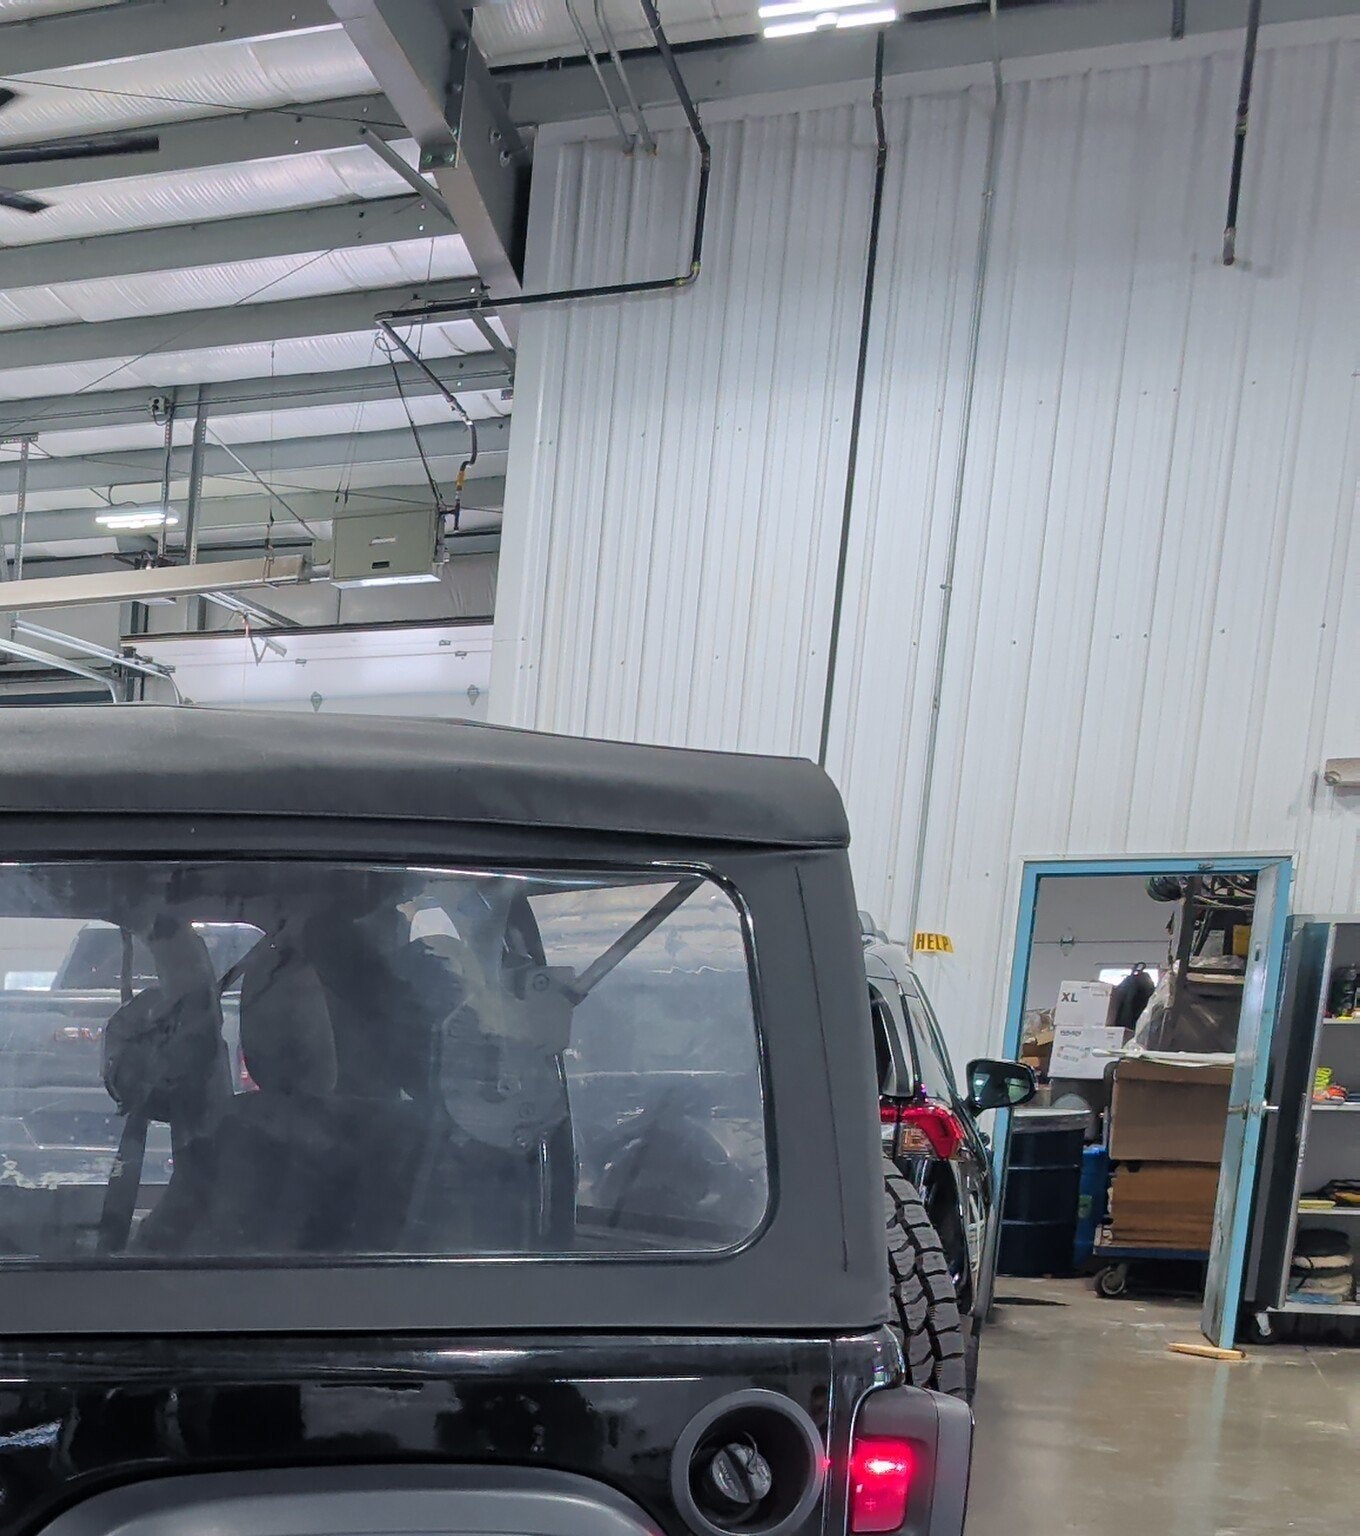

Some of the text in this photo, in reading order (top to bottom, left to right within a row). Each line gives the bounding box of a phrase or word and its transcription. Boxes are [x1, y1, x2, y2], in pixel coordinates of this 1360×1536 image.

[915, 933, 950, 951] HELP
[1061, 992, 1079, 1003] XL
[54, 1027, 105, 1043] GM
